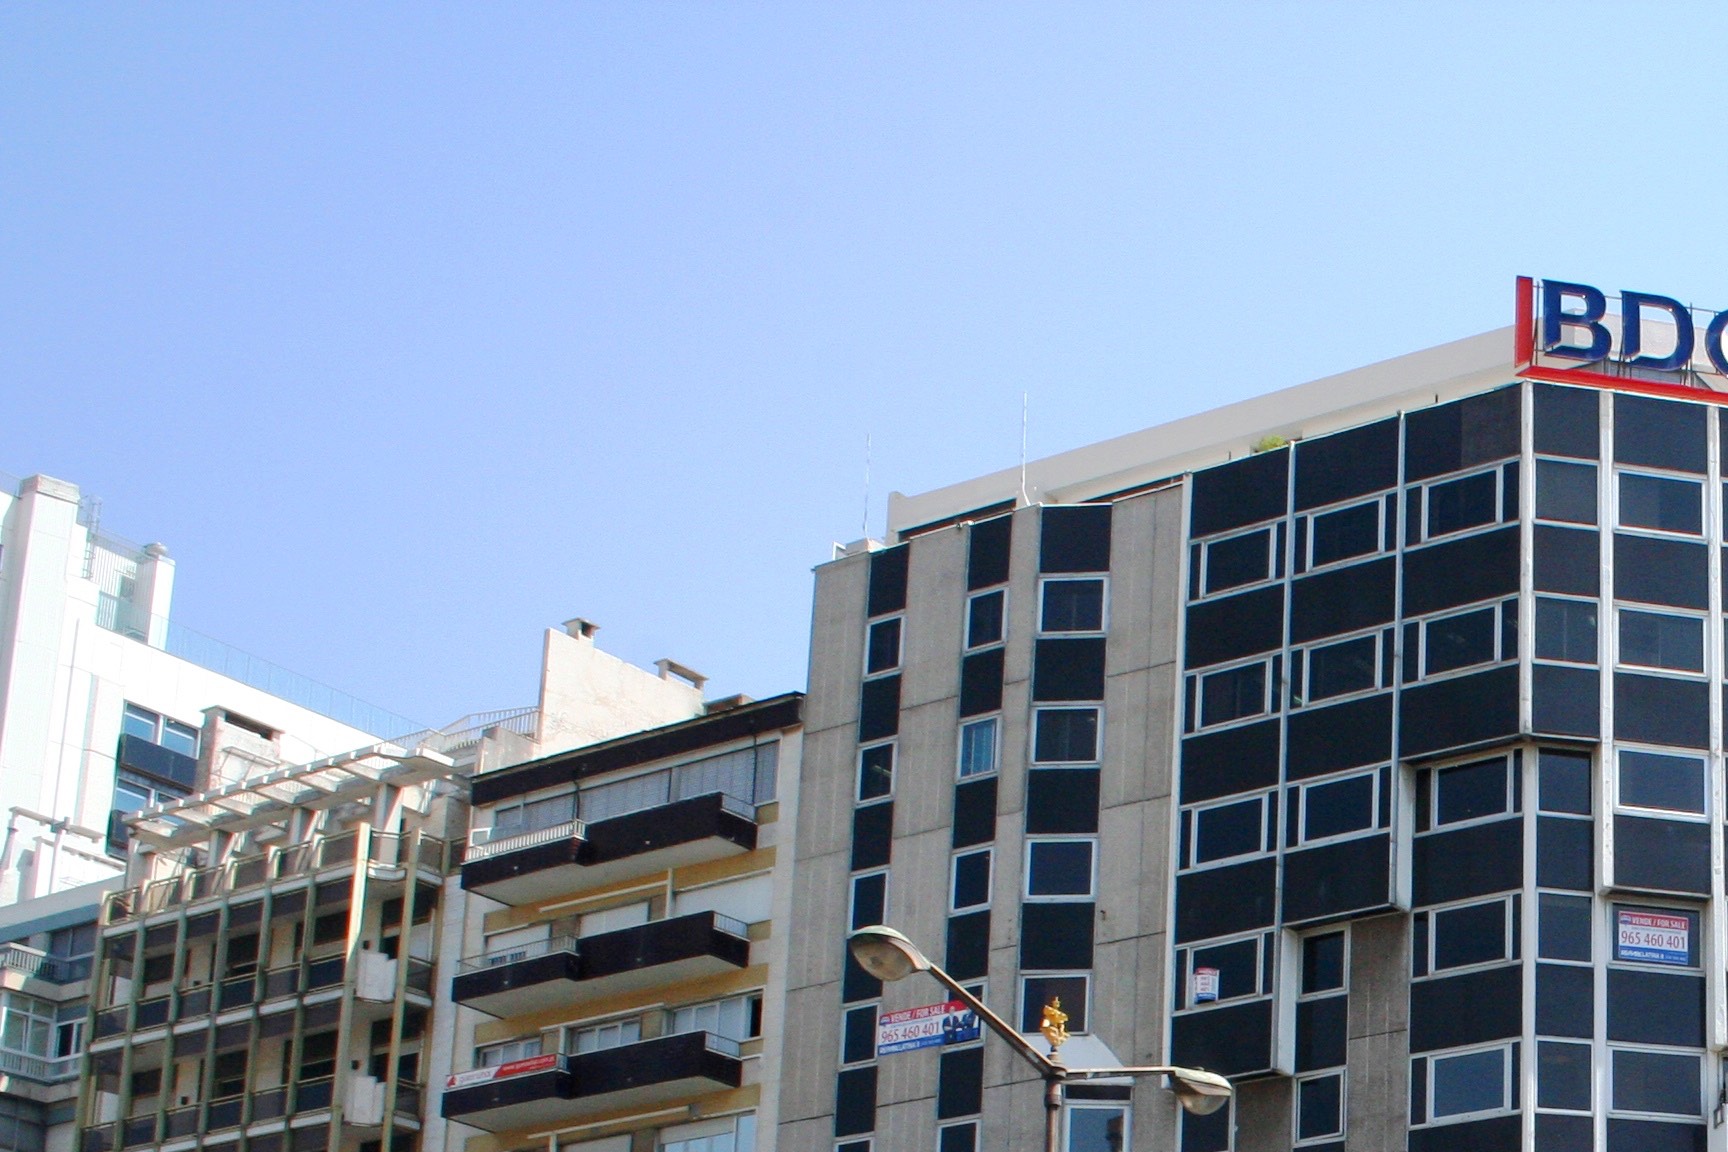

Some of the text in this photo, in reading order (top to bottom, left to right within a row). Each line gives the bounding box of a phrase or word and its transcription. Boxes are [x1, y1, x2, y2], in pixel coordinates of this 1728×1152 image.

[1657, 919, 1669, 928] FOR
[1670, 921, 1686, 929] SALE
[1621, 931, 1685, 949] 965 460 401
[916, 1008, 929, 1019] FOR
[930, 1005, 945, 1017] SALE
[881, 1029, 899, 1043] 965
[901, 1025, 920, 1040] 460
[922, 1021, 940, 1036] 401
